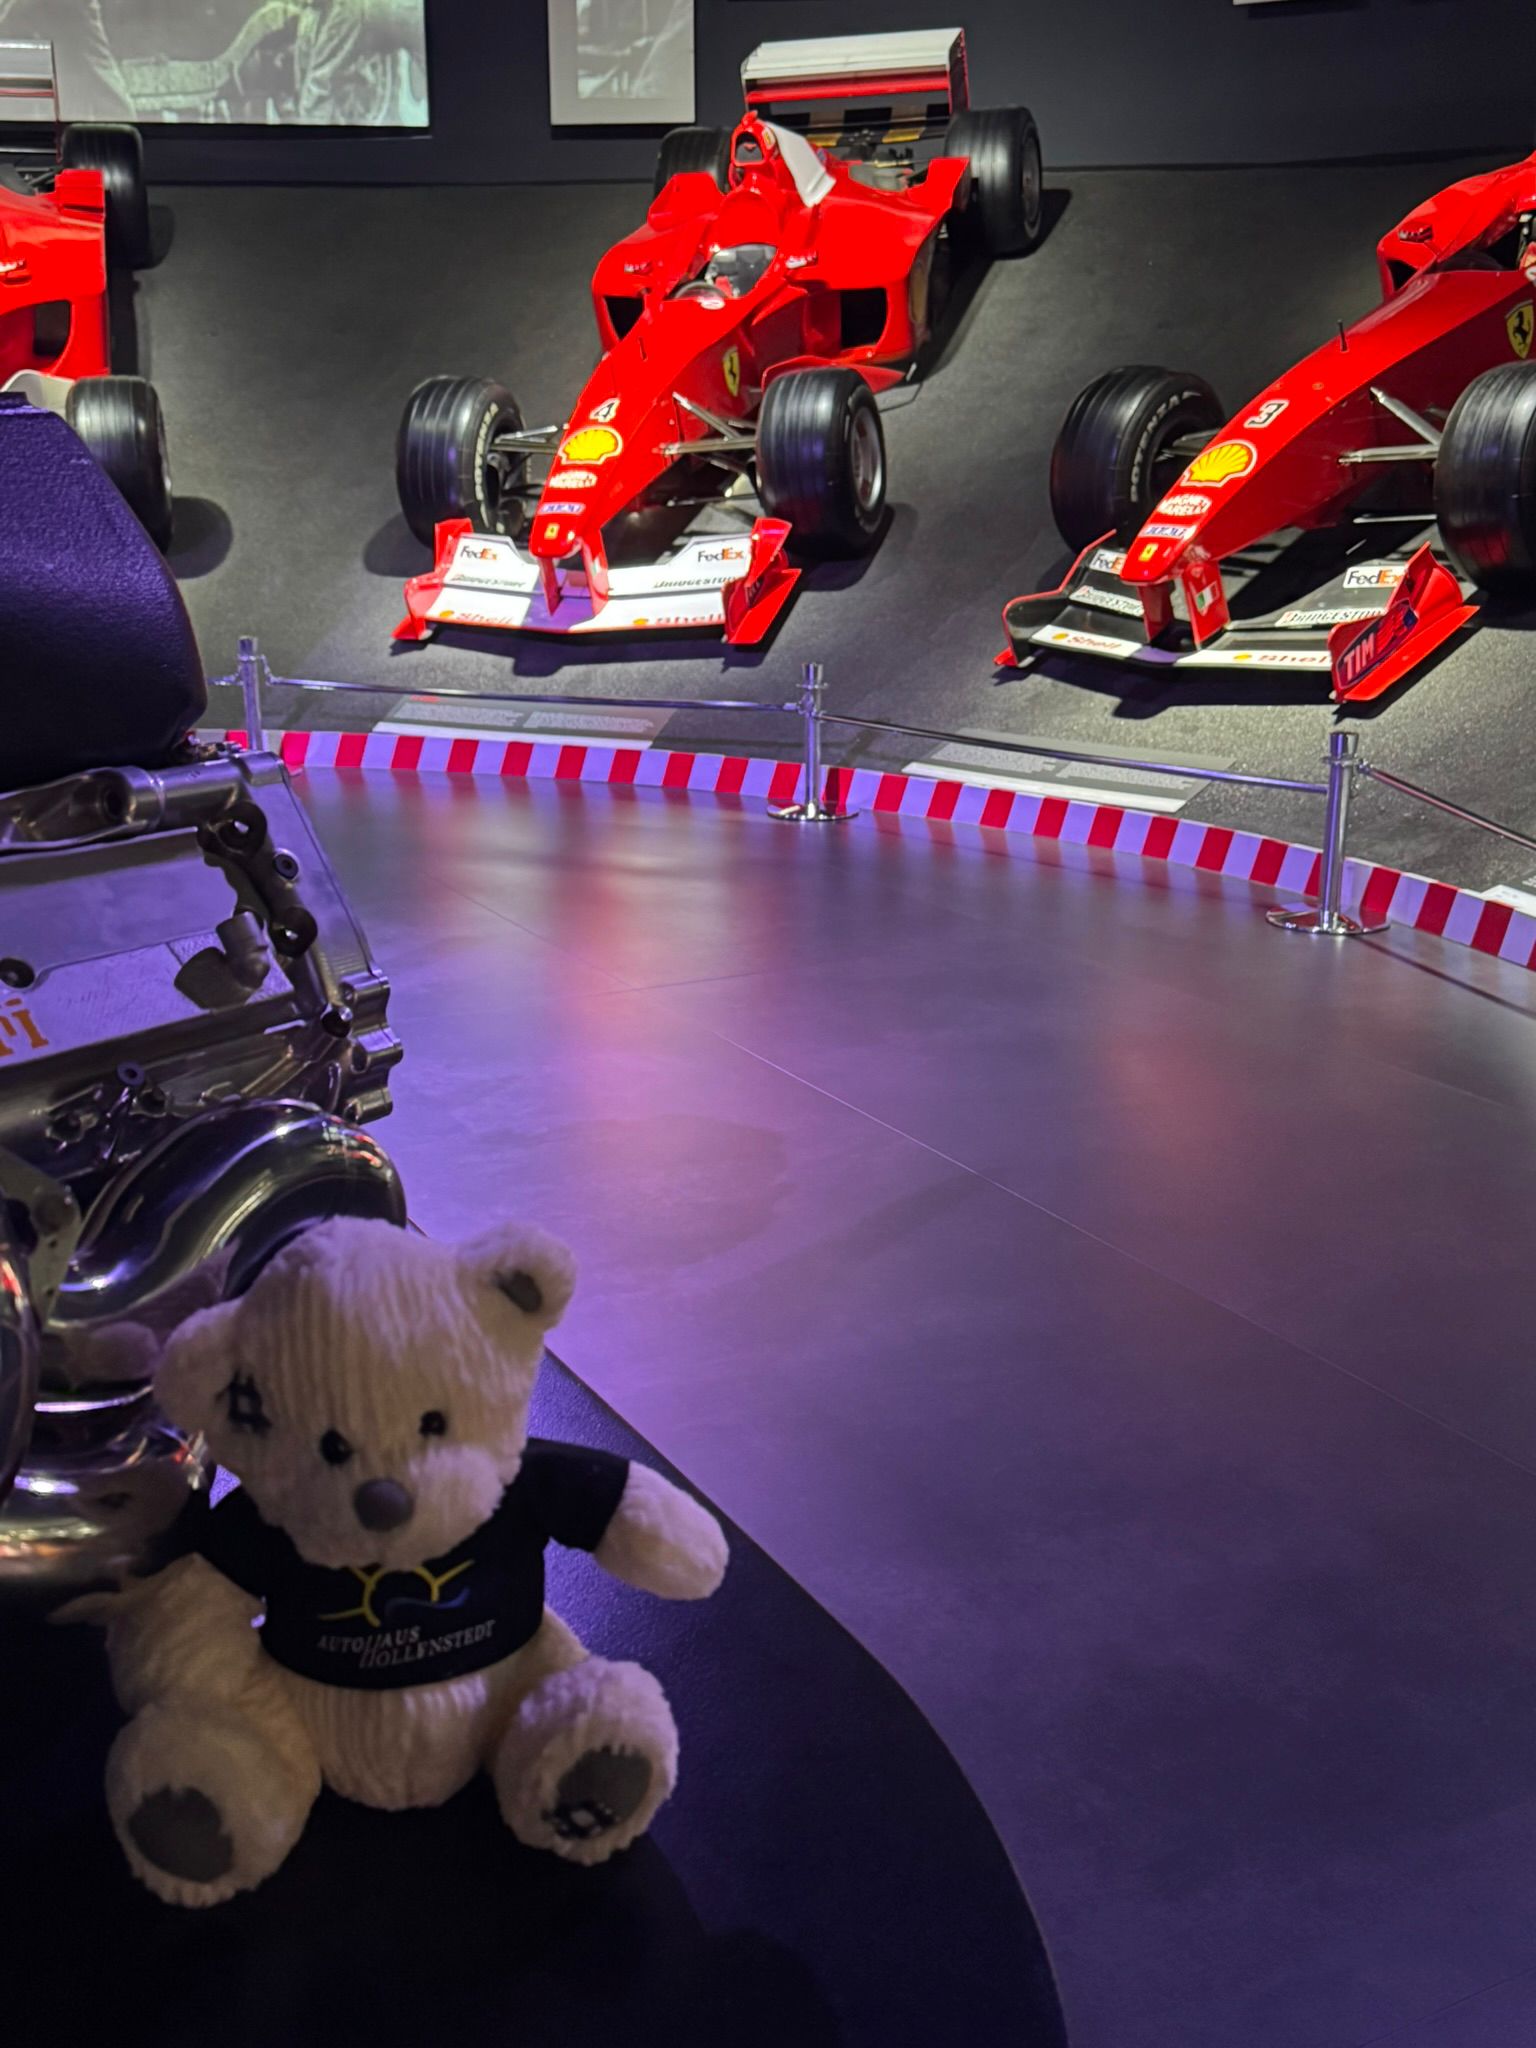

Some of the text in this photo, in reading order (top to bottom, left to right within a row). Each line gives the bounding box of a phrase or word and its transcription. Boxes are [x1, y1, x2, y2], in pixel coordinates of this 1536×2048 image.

[590, 398, 619, 422] 4
[1244, 399, 1289, 429] 3
[461, 546, 498, 561] FedEx
[698, 547, 744, 562] FedEx
[1093, 553, 1125, 571] FedE
[1344, 631, 1375, 681] TIM
[318, 1625, 420, 1652] AUTOHAUS
[359, 1618, 496, 1668] HOLLENSTEDT
